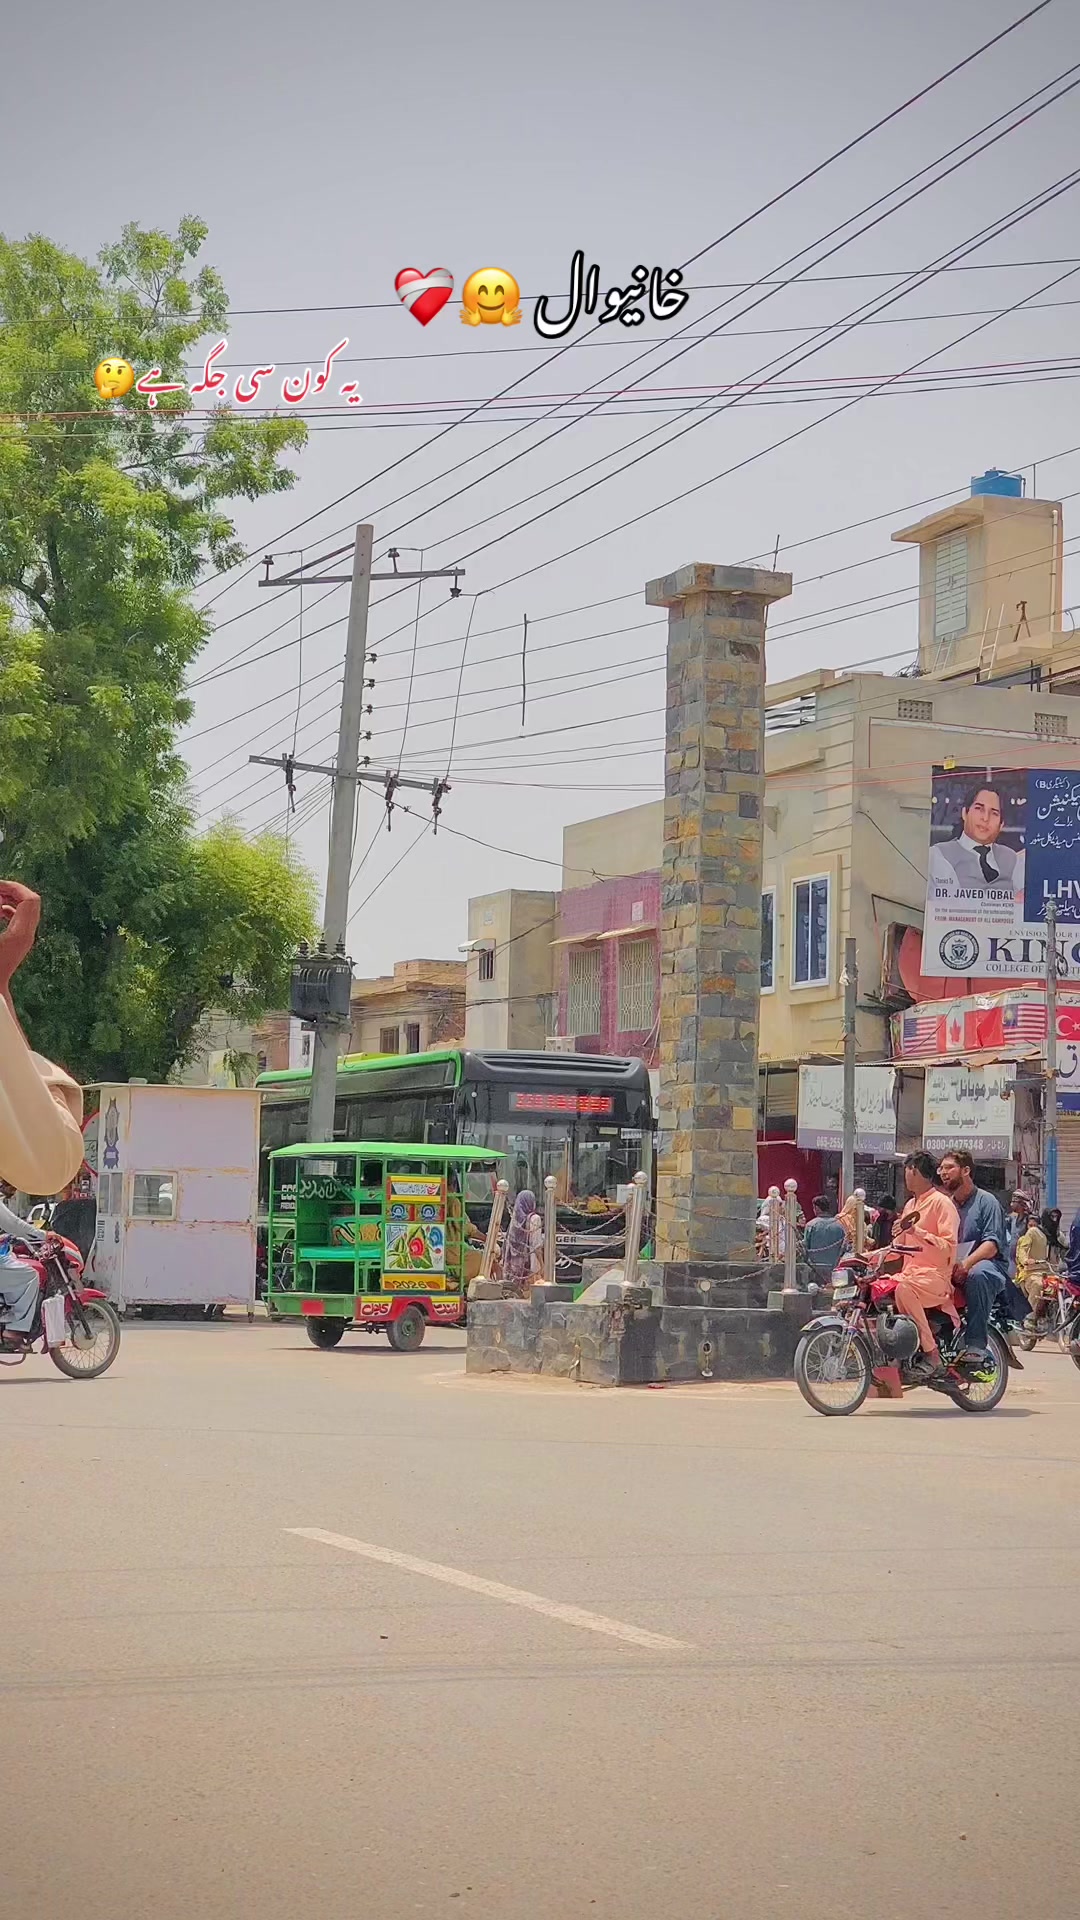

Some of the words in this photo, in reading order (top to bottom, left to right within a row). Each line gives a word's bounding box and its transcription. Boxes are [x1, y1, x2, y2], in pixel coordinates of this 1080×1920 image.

[935, 888, 951, 898] DR.
[954, 889, 984, 899] JAVED
[987, 890, 1014, 900] IQBAL
[985, 963, 1028, 973] COLLEGE
[1031, 965, 1044, 973] OF
[556, 1235, 577, 1243] GER
[393, 1281, 427, 1289] 2026
